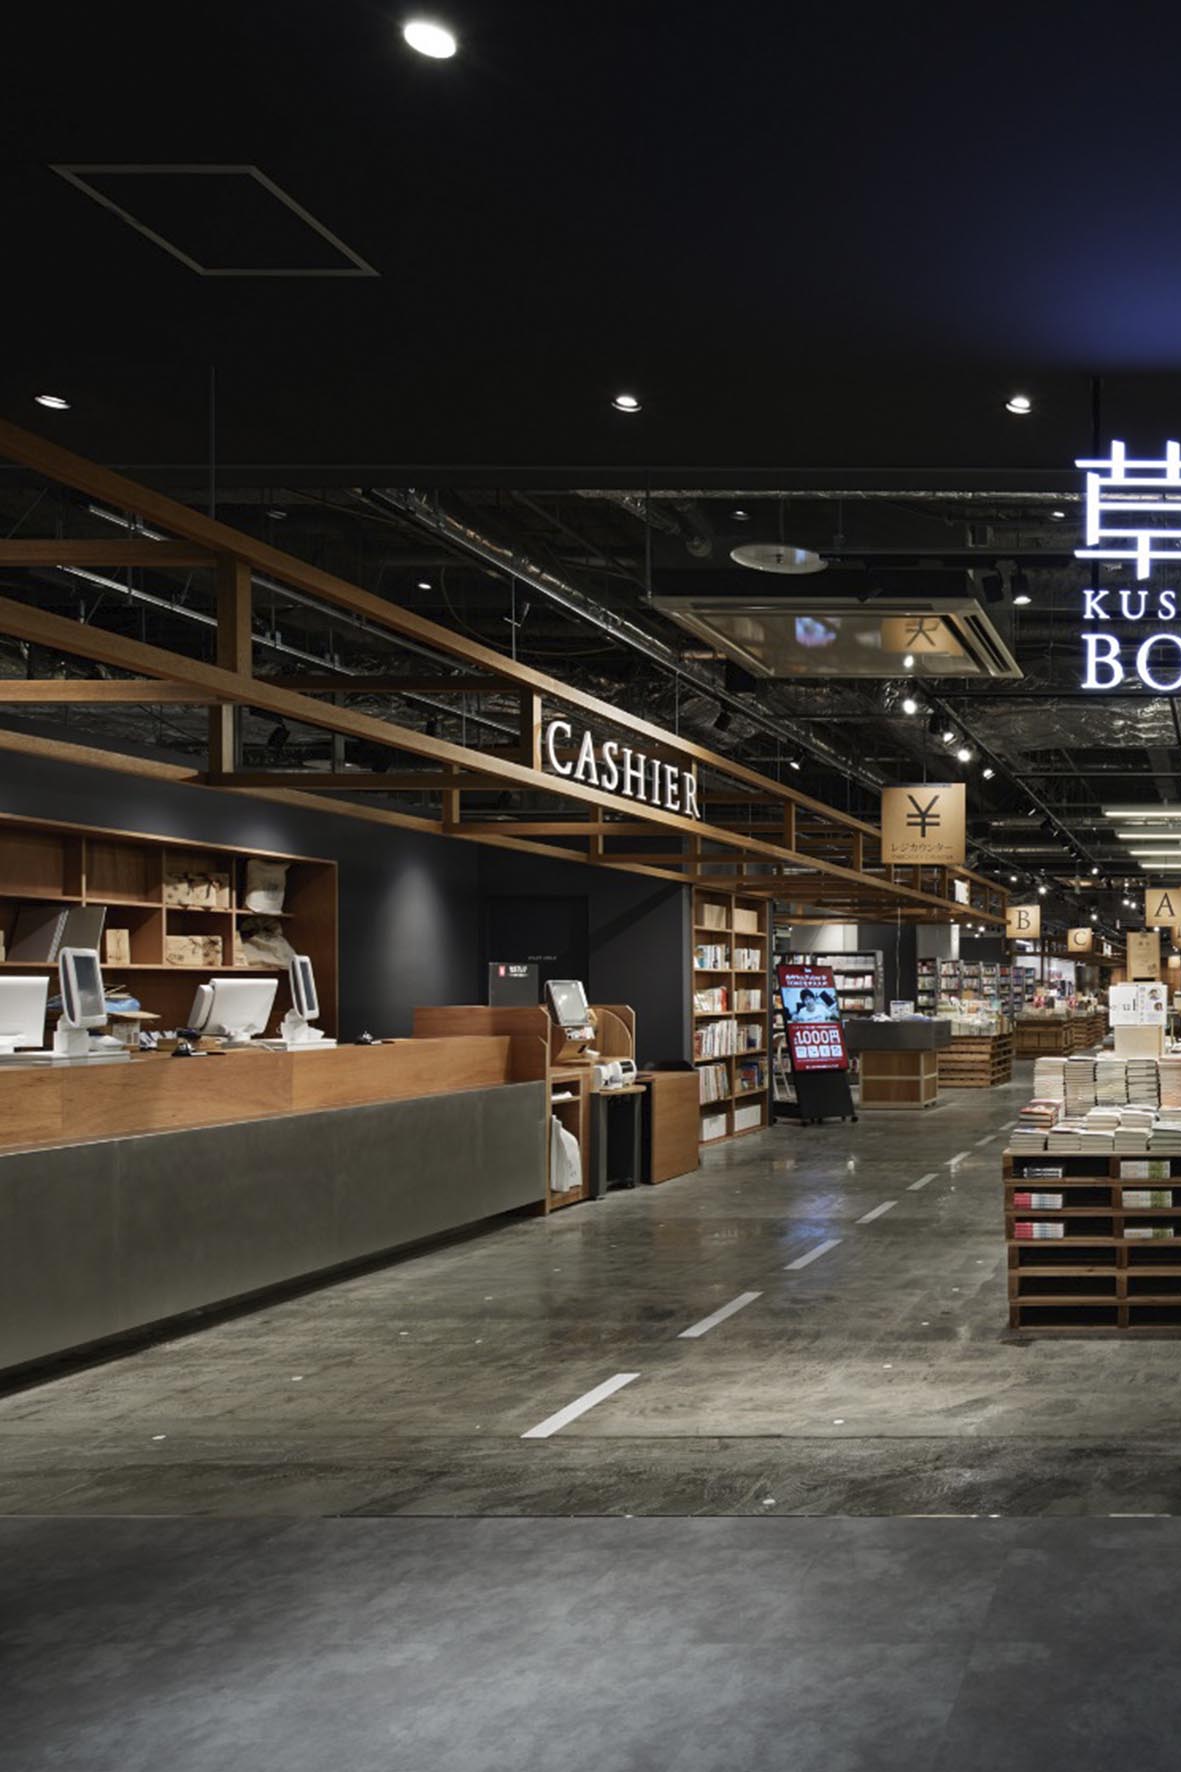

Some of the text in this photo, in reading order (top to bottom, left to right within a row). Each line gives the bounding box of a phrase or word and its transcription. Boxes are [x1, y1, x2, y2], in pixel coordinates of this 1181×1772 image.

[545, 720, 701, 819] CASHIER
[1154, 892, 1176, 917] A
[1016, 910, 1031, 930] B
[1073, 930, 1087, 946] C
